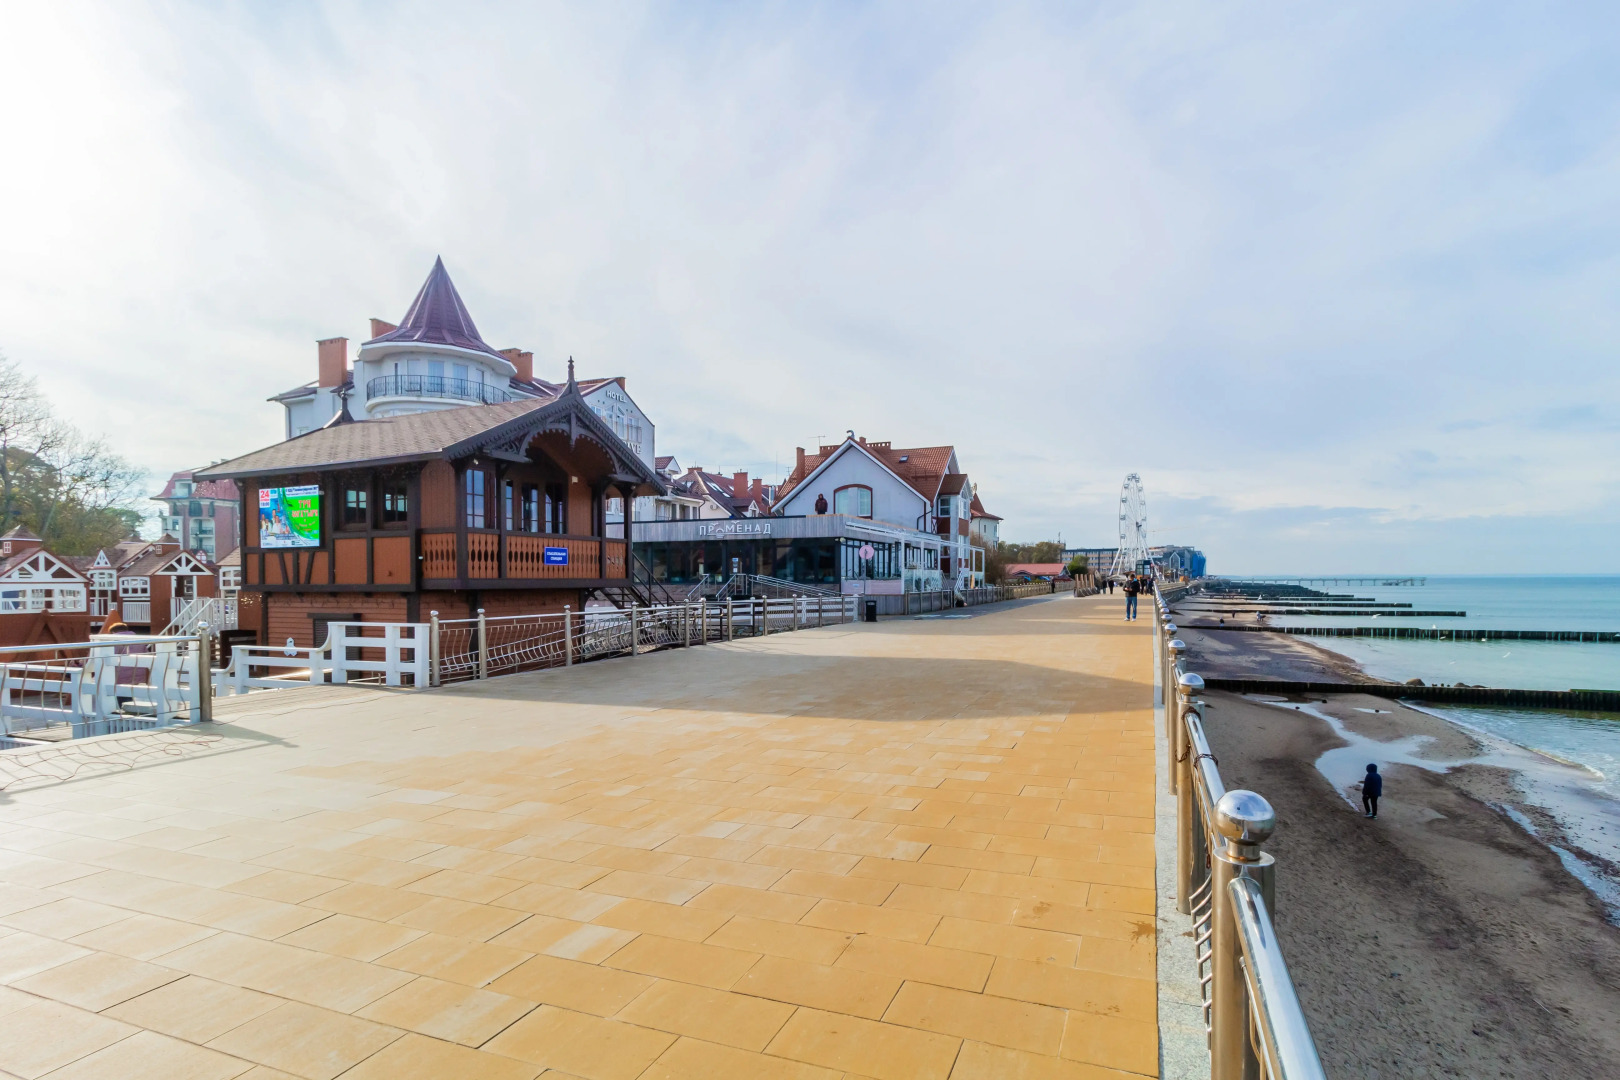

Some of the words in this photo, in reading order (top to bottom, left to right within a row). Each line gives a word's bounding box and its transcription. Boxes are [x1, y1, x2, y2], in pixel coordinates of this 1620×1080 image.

[605, 390, 627, 403] HOTEL
[260, 490, 270, 498] 24
[699, 523, 771, 537] ПРОМЕНАД
